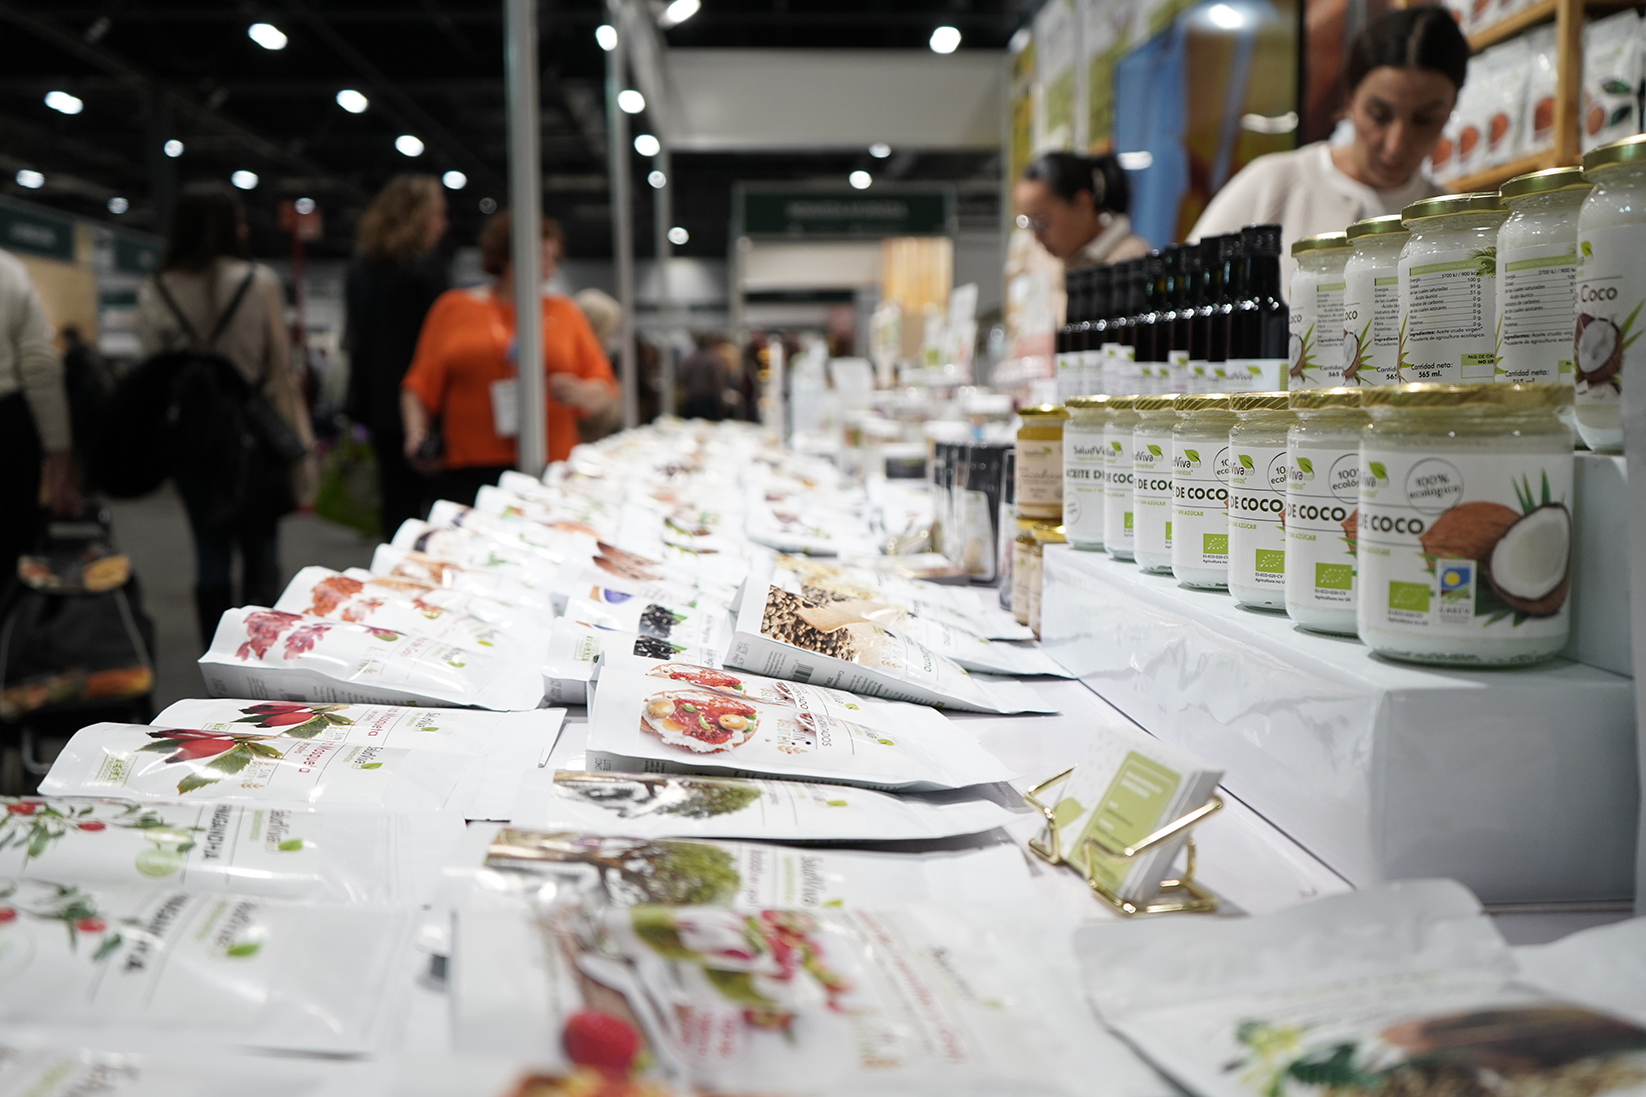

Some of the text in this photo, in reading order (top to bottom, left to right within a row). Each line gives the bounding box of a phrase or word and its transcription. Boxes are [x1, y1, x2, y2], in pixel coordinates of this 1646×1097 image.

[1580, 284, 1618, 303] Coco
[1066, 470, 1090, 479] ACEITE
[1416, 474, 1450, 486] 100%
[1138, 479, 1148, 490] DE
[1176, 487, 1228, 500] DE COCO
[1231, 496, 1284, 512] DE COCO
[1287, 504, 1346, 521] DE COCO
[1372, 516, 1424, 534] COCO
